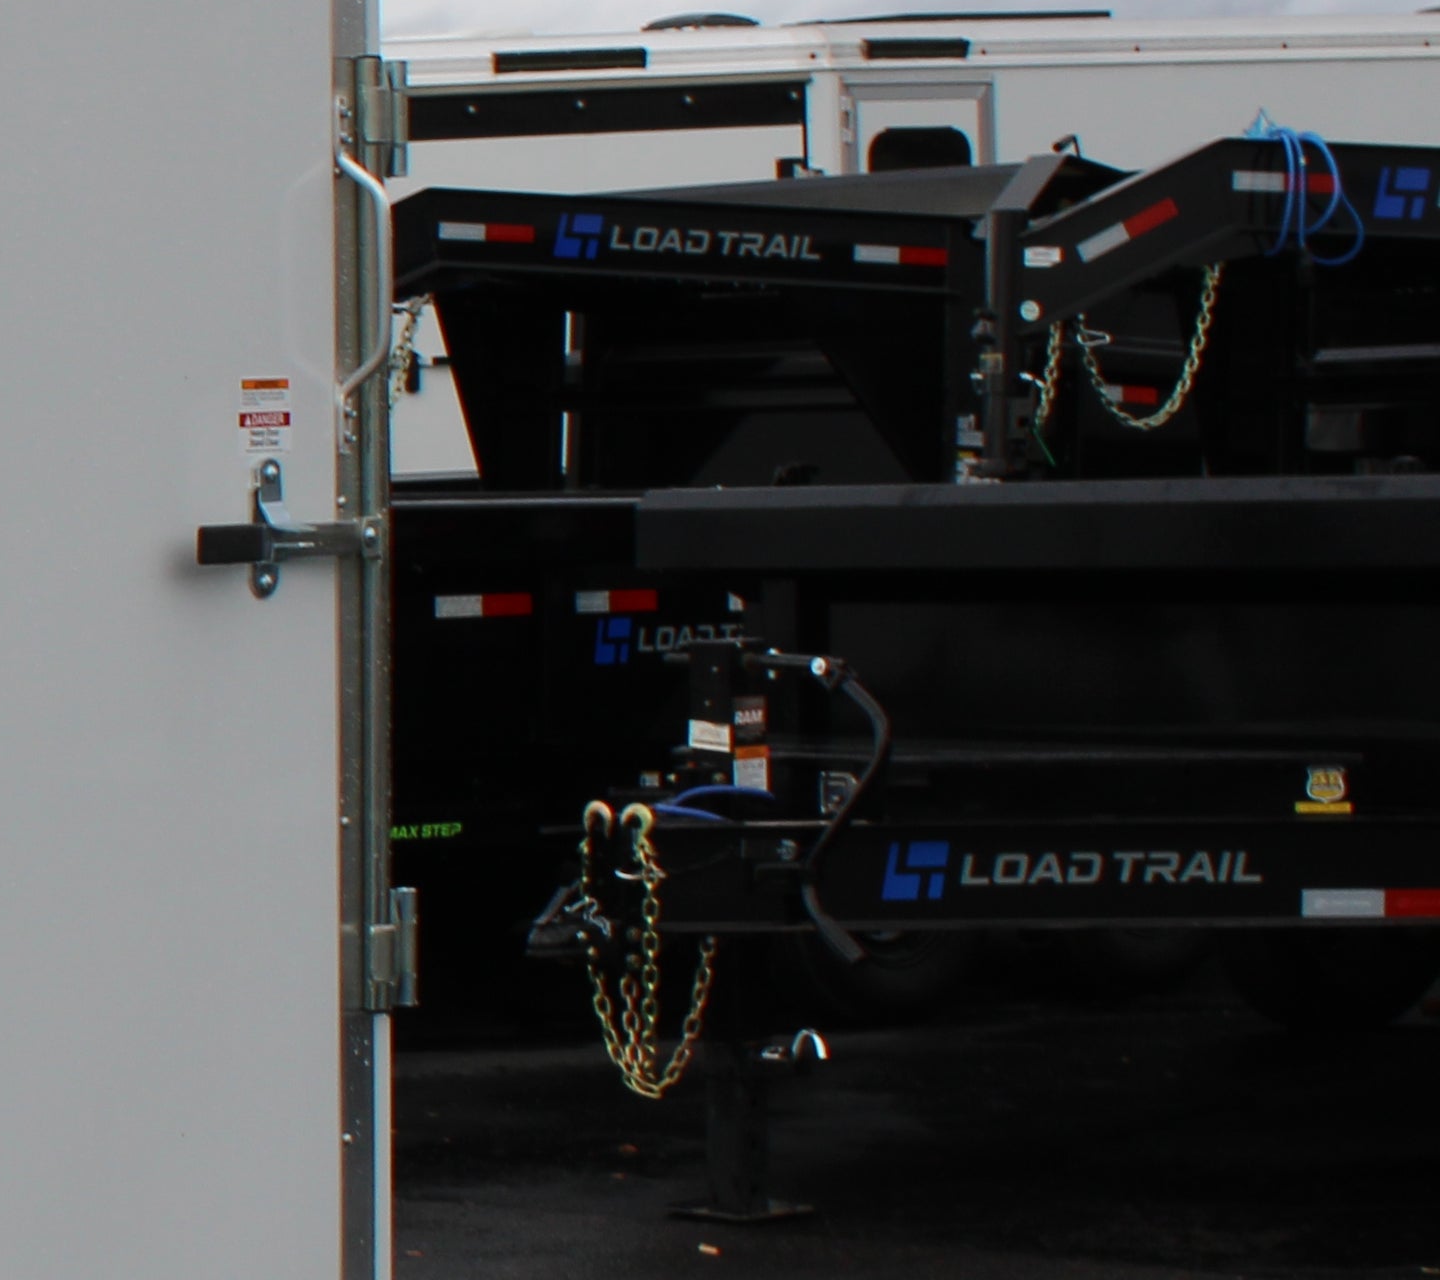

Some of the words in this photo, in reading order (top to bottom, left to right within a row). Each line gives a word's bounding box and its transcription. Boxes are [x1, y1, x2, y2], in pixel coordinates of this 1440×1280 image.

[609, 224, 711, 255] LOAD
[717, 230, 822, 261] TRAIL
[251, 412, 285, 426] DANGER
[959, 851, 1105, 886] LOAD
[1113, 850, 1264, 884] TRAIL
